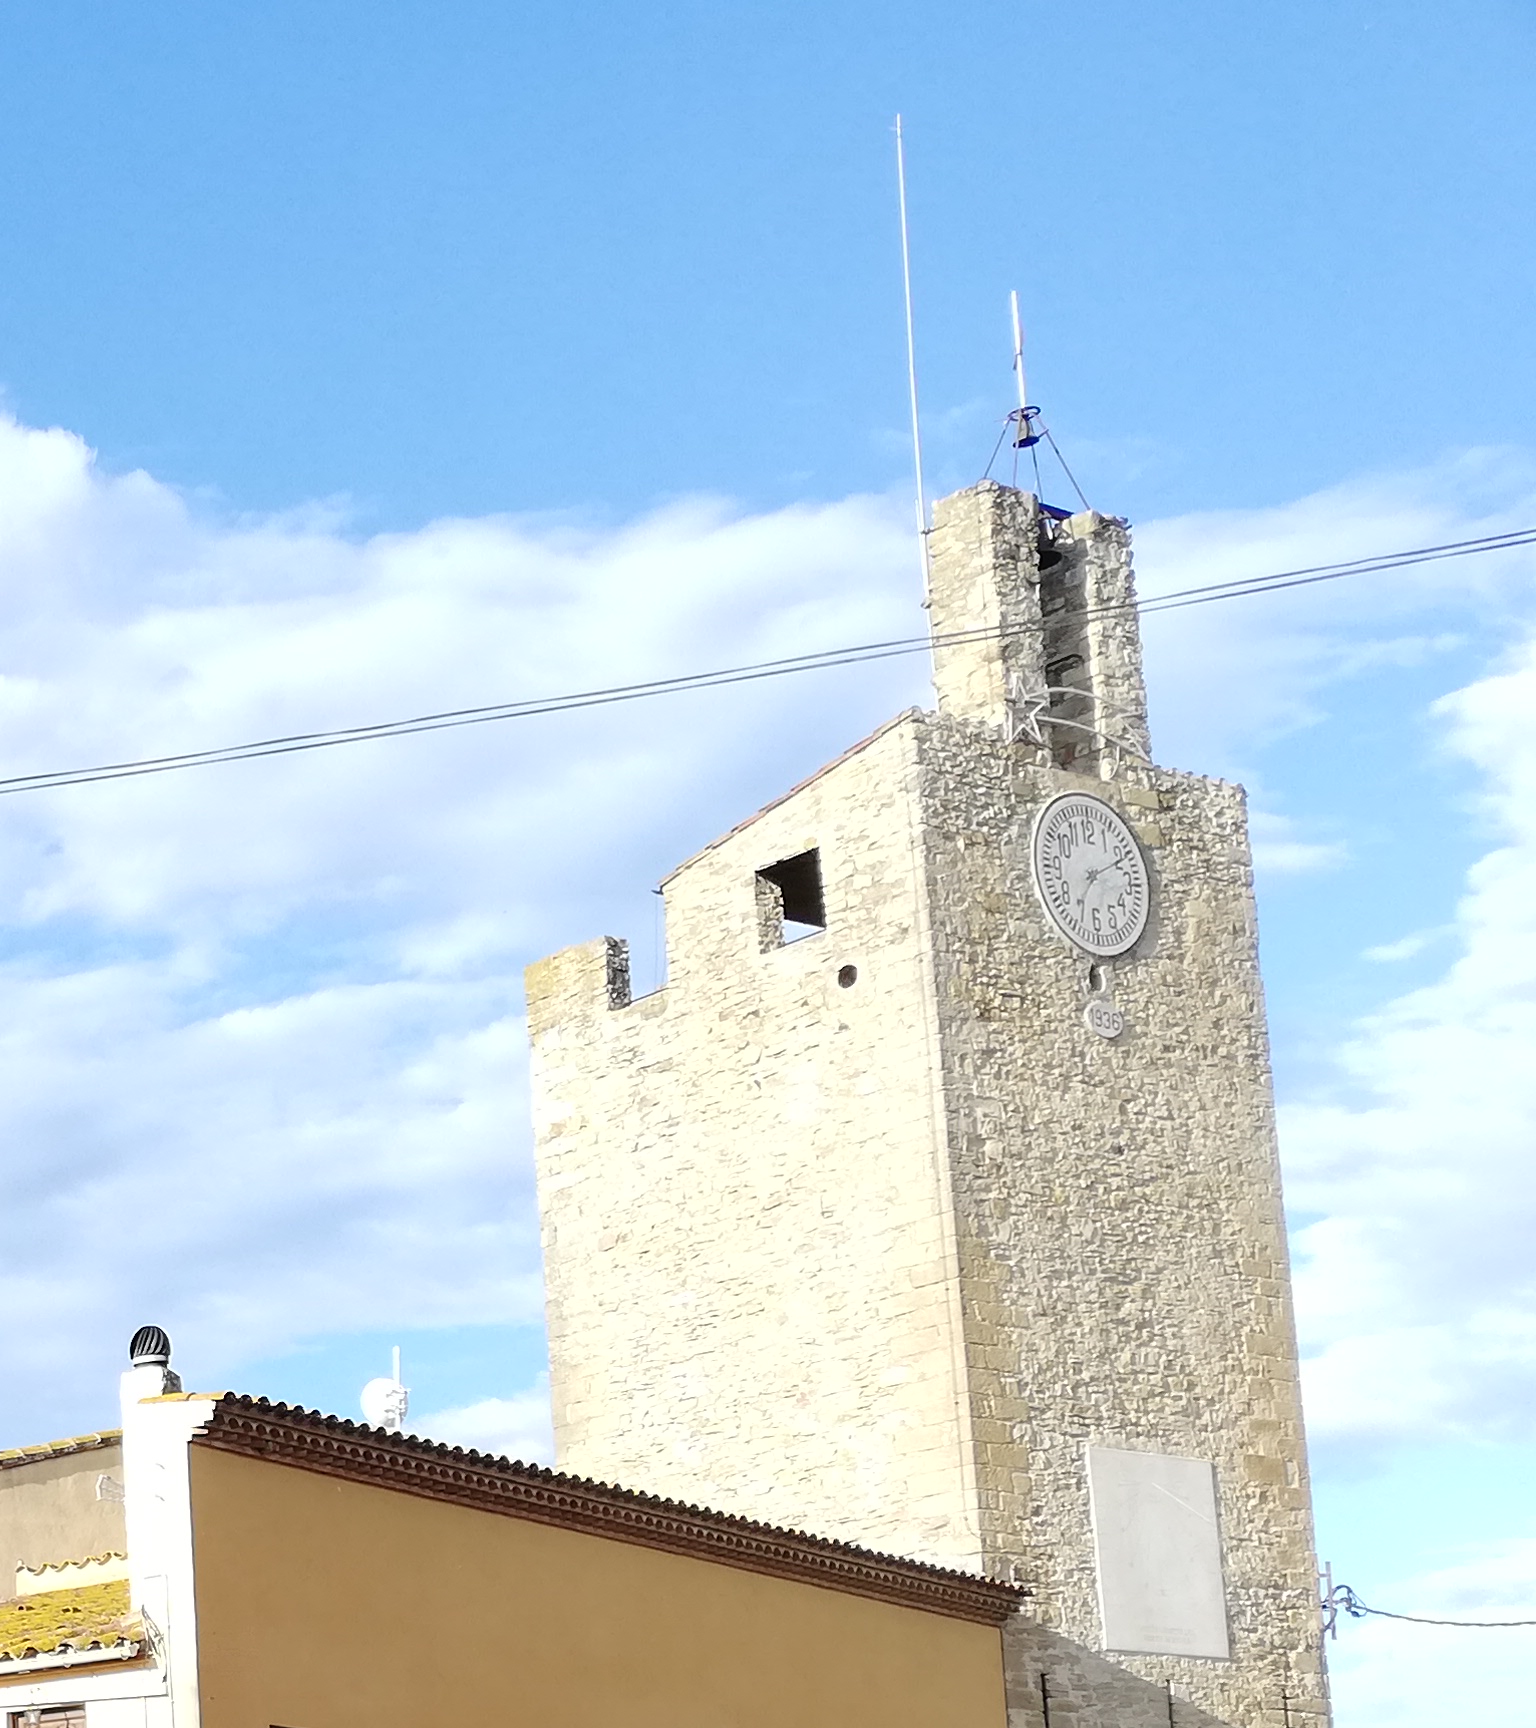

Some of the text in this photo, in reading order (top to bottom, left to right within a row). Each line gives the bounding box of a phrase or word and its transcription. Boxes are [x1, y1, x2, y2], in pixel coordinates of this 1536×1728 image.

[1069, 820, 1078, 847] 11
[1082, 820, 1095, 845] 12
[1101, 828, 1108, 853] 1
[1058, 833, 1070, 858] 10
[1053, 855, 1062, 880] 9
[1114, 846, 1124, 870] 2
[1061, 880, 1069, 905] 8
[1123, 872, 1133, 896] 3
[1077, 899, 1084, 923] 7
[1107, 905, 1116, 929] 5
[1117, 893, 1126, 917] 4
[1092, 908, 1101, 932] 6
